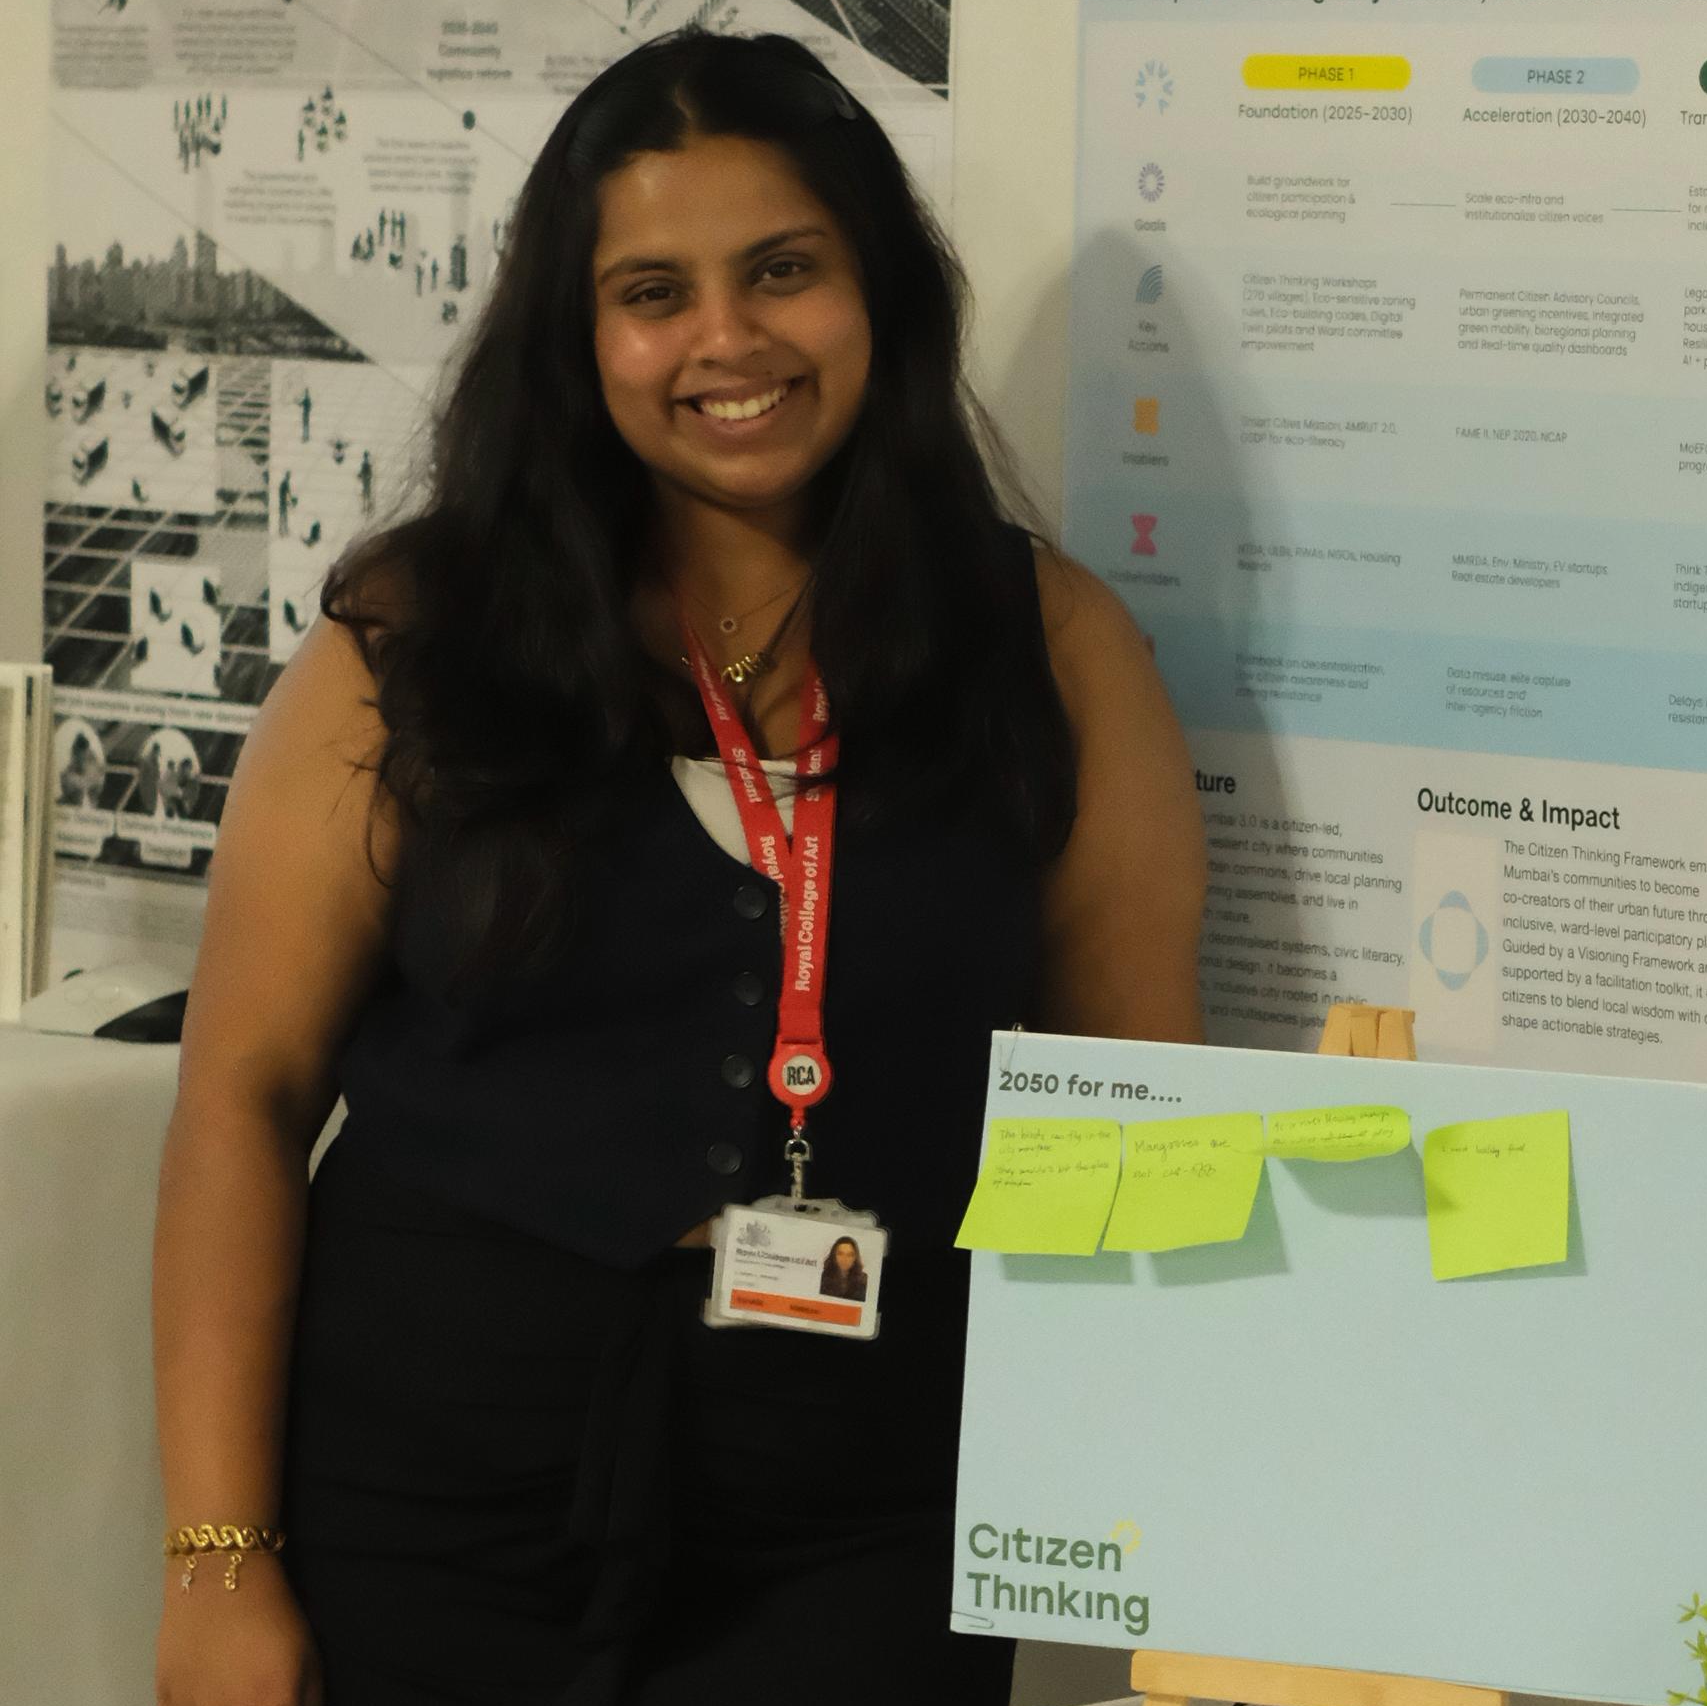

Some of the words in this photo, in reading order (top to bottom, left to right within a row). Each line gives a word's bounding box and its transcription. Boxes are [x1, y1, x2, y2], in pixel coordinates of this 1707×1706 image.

[1298, 67, 1344, 82] PHASE
[1528, 69, 1572, 84] PHASE
[1576, 69, 1584, 84] 2
[1418, 787, 1512, 820] Outcome
[1520, 798, 1534, 822] &
[1542, 799, 1620, 831] Impact
[802, 836, 819, 860] Art
[1504, 839, 1525, 855] The
[1528, 842, 1568, 858] Citizen
[1572, 845, 1620, 867] Thinking
[1624, 851, 1685, 870] Framework
[802, 861, 818, 877] of
[1504, 864, 1559, 883] Mumbai's
[1562, 873, 1636, 891] communities
[1640, 879, 1651, 892] to
[1654, 879, 1699, 898] become
[795, 879, 819, 943] College
[794, 945, 814, 991] Royal
[787, 1065, 815, 1087] RCA
[1000, 1071, 1060, 1095] 2050
[1068, 1074, 1103, 1098] for
[1111, 1081, 1183, 1104] me....
[968, 1522, 1123, 1573] Citizen
[966, 1571, 1150, 1636] Thinking
